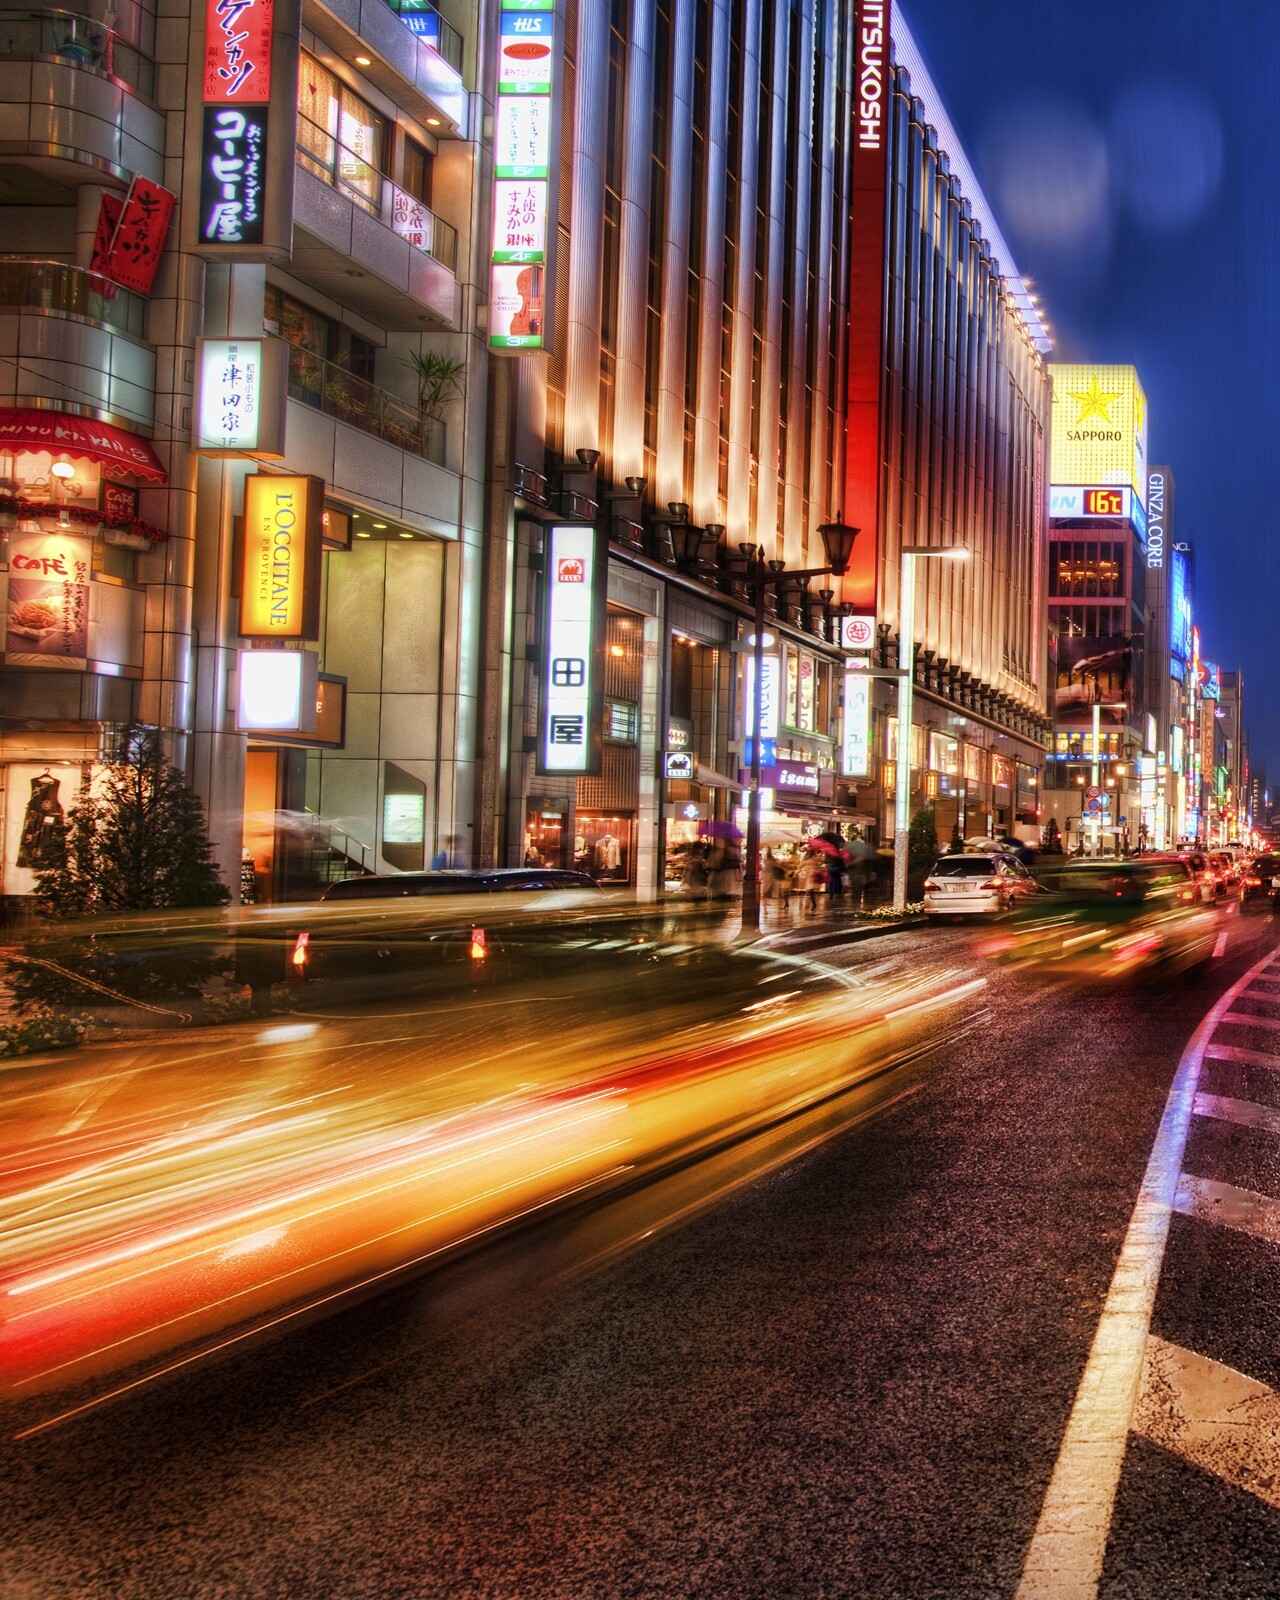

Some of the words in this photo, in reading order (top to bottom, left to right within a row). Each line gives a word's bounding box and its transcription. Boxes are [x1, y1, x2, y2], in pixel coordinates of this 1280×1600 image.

[860, 0, 883, 149] ITSUKOSHI
[205, 111, 246, 241] コーヒー屋
[507, 191, 521, 230] すみか
[523, 186, 536, 224] 天使の
[506, 234, 535, 247] 銀座
[510, 251, 533, 260] 4F
[1066, 430, 1122, 442] SAPPORO
[1148, 473, 1164, 523] GINZA
[263, 517, 271, 532] EN
[270, 493, 296, 626] L'OCCITANE
[1147, 525, 1163, 568] CORE
[260, 538, 269, 602] PROVENCE
[550, 657, 586, 745] 田屋
